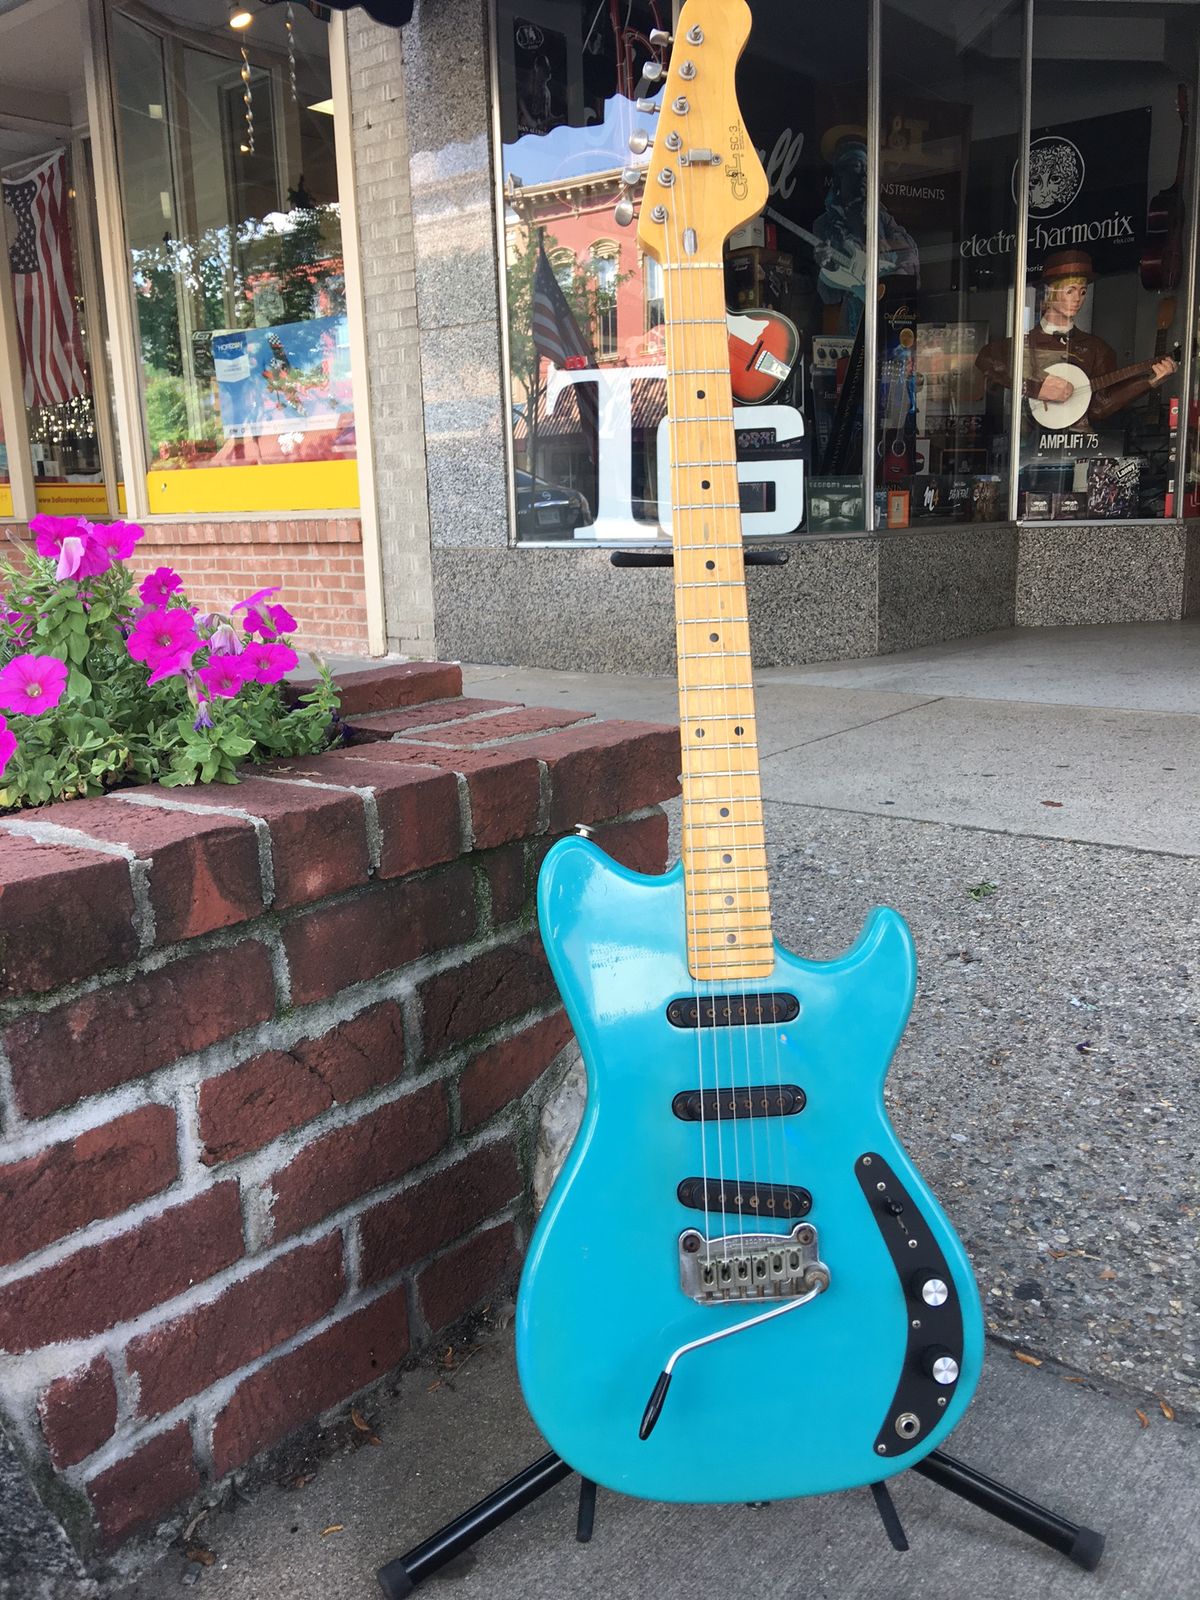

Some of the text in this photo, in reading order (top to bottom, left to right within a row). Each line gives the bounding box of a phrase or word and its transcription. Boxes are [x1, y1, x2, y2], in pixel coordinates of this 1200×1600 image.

[880, 183, 945, 201] NSTRUMENTS
[960, 210, 1134, 258] electr-harmonix
[1039, 433, 1099, 449] AMPLIFi 75
